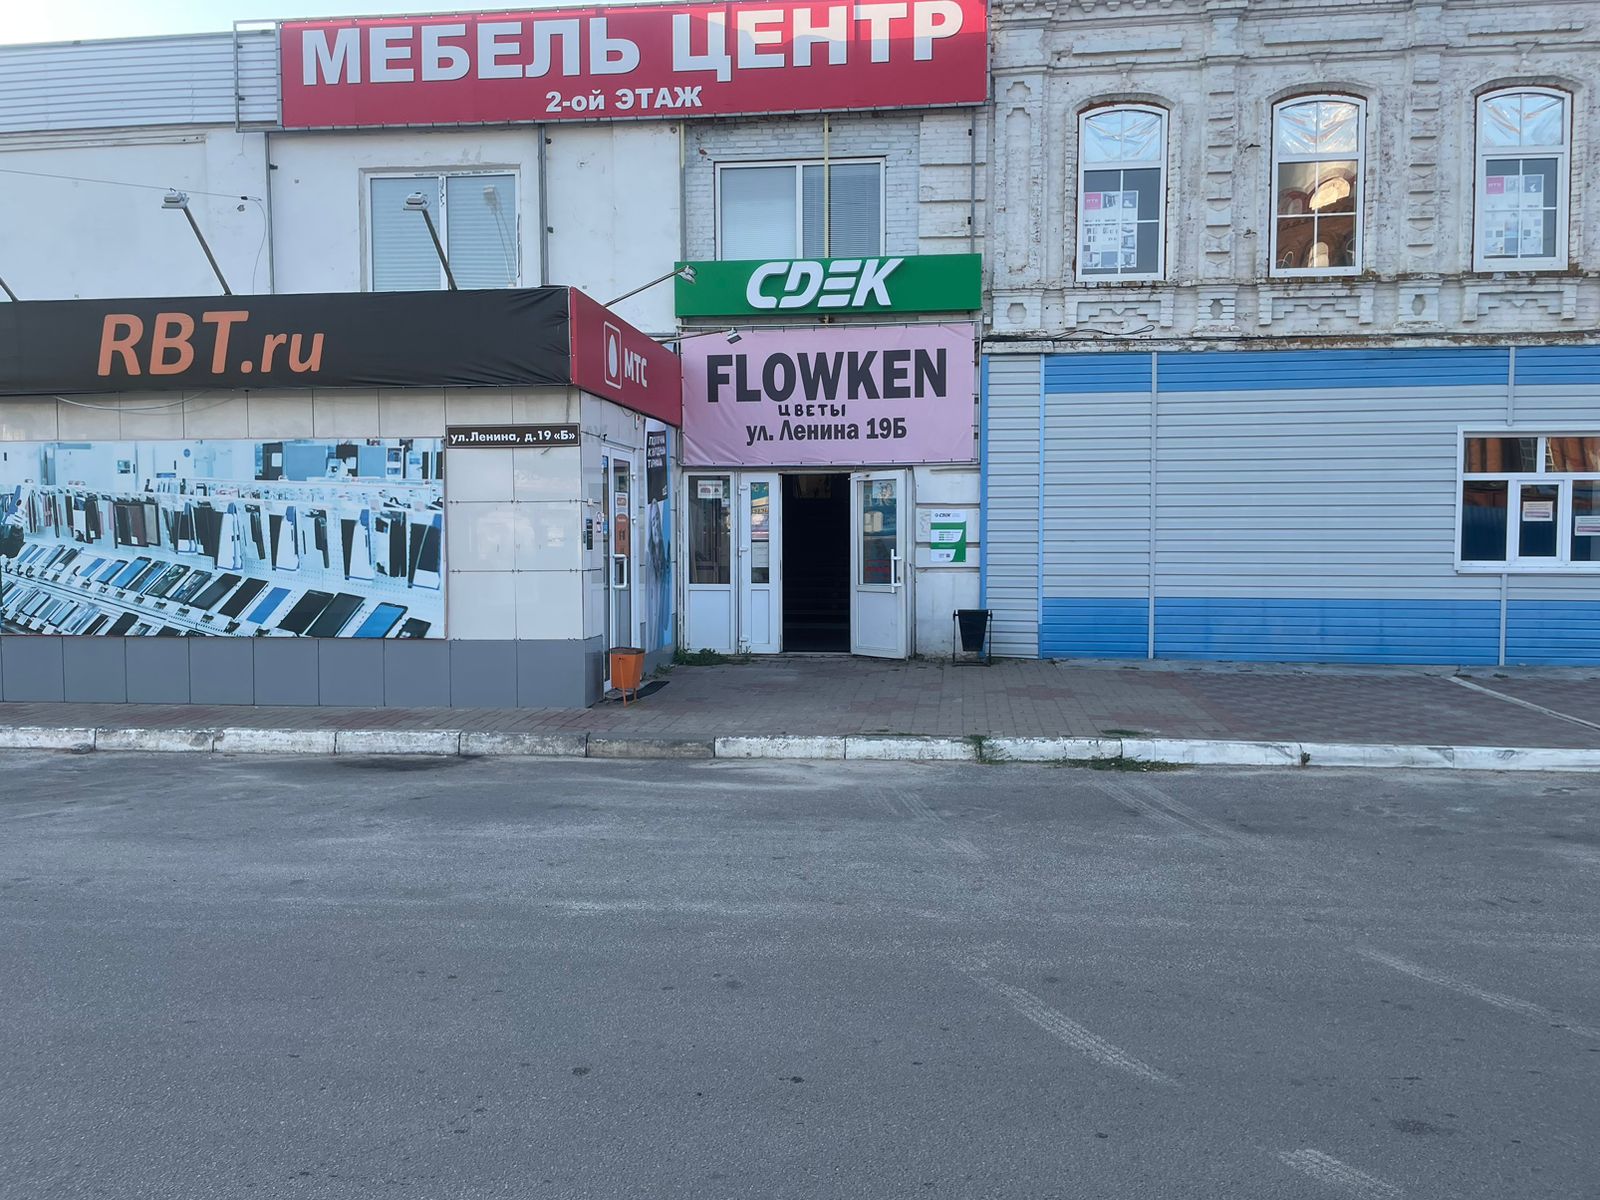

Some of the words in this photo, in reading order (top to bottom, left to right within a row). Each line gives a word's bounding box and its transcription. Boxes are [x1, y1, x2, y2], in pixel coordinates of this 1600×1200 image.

[302, 17, 640, 86] МЕБЕЛЬ
[672, 0, 963, 82] ЦЕНТР
[545, 89, 605, 112] 2-ой
[615, 86, 702, 110] ЭТАЖ
[746, 258, 904, 309] CDEK
[97, 310, 324, 376] RBT.ru
[624, 347, 648, 388] МТС
[707, 348, 947, 403] FLOWKEN
[746, 425, 774, 446] ул.
[780, 420, 859, 441] Ленина
[866, 418, 907, 439] 19Б
